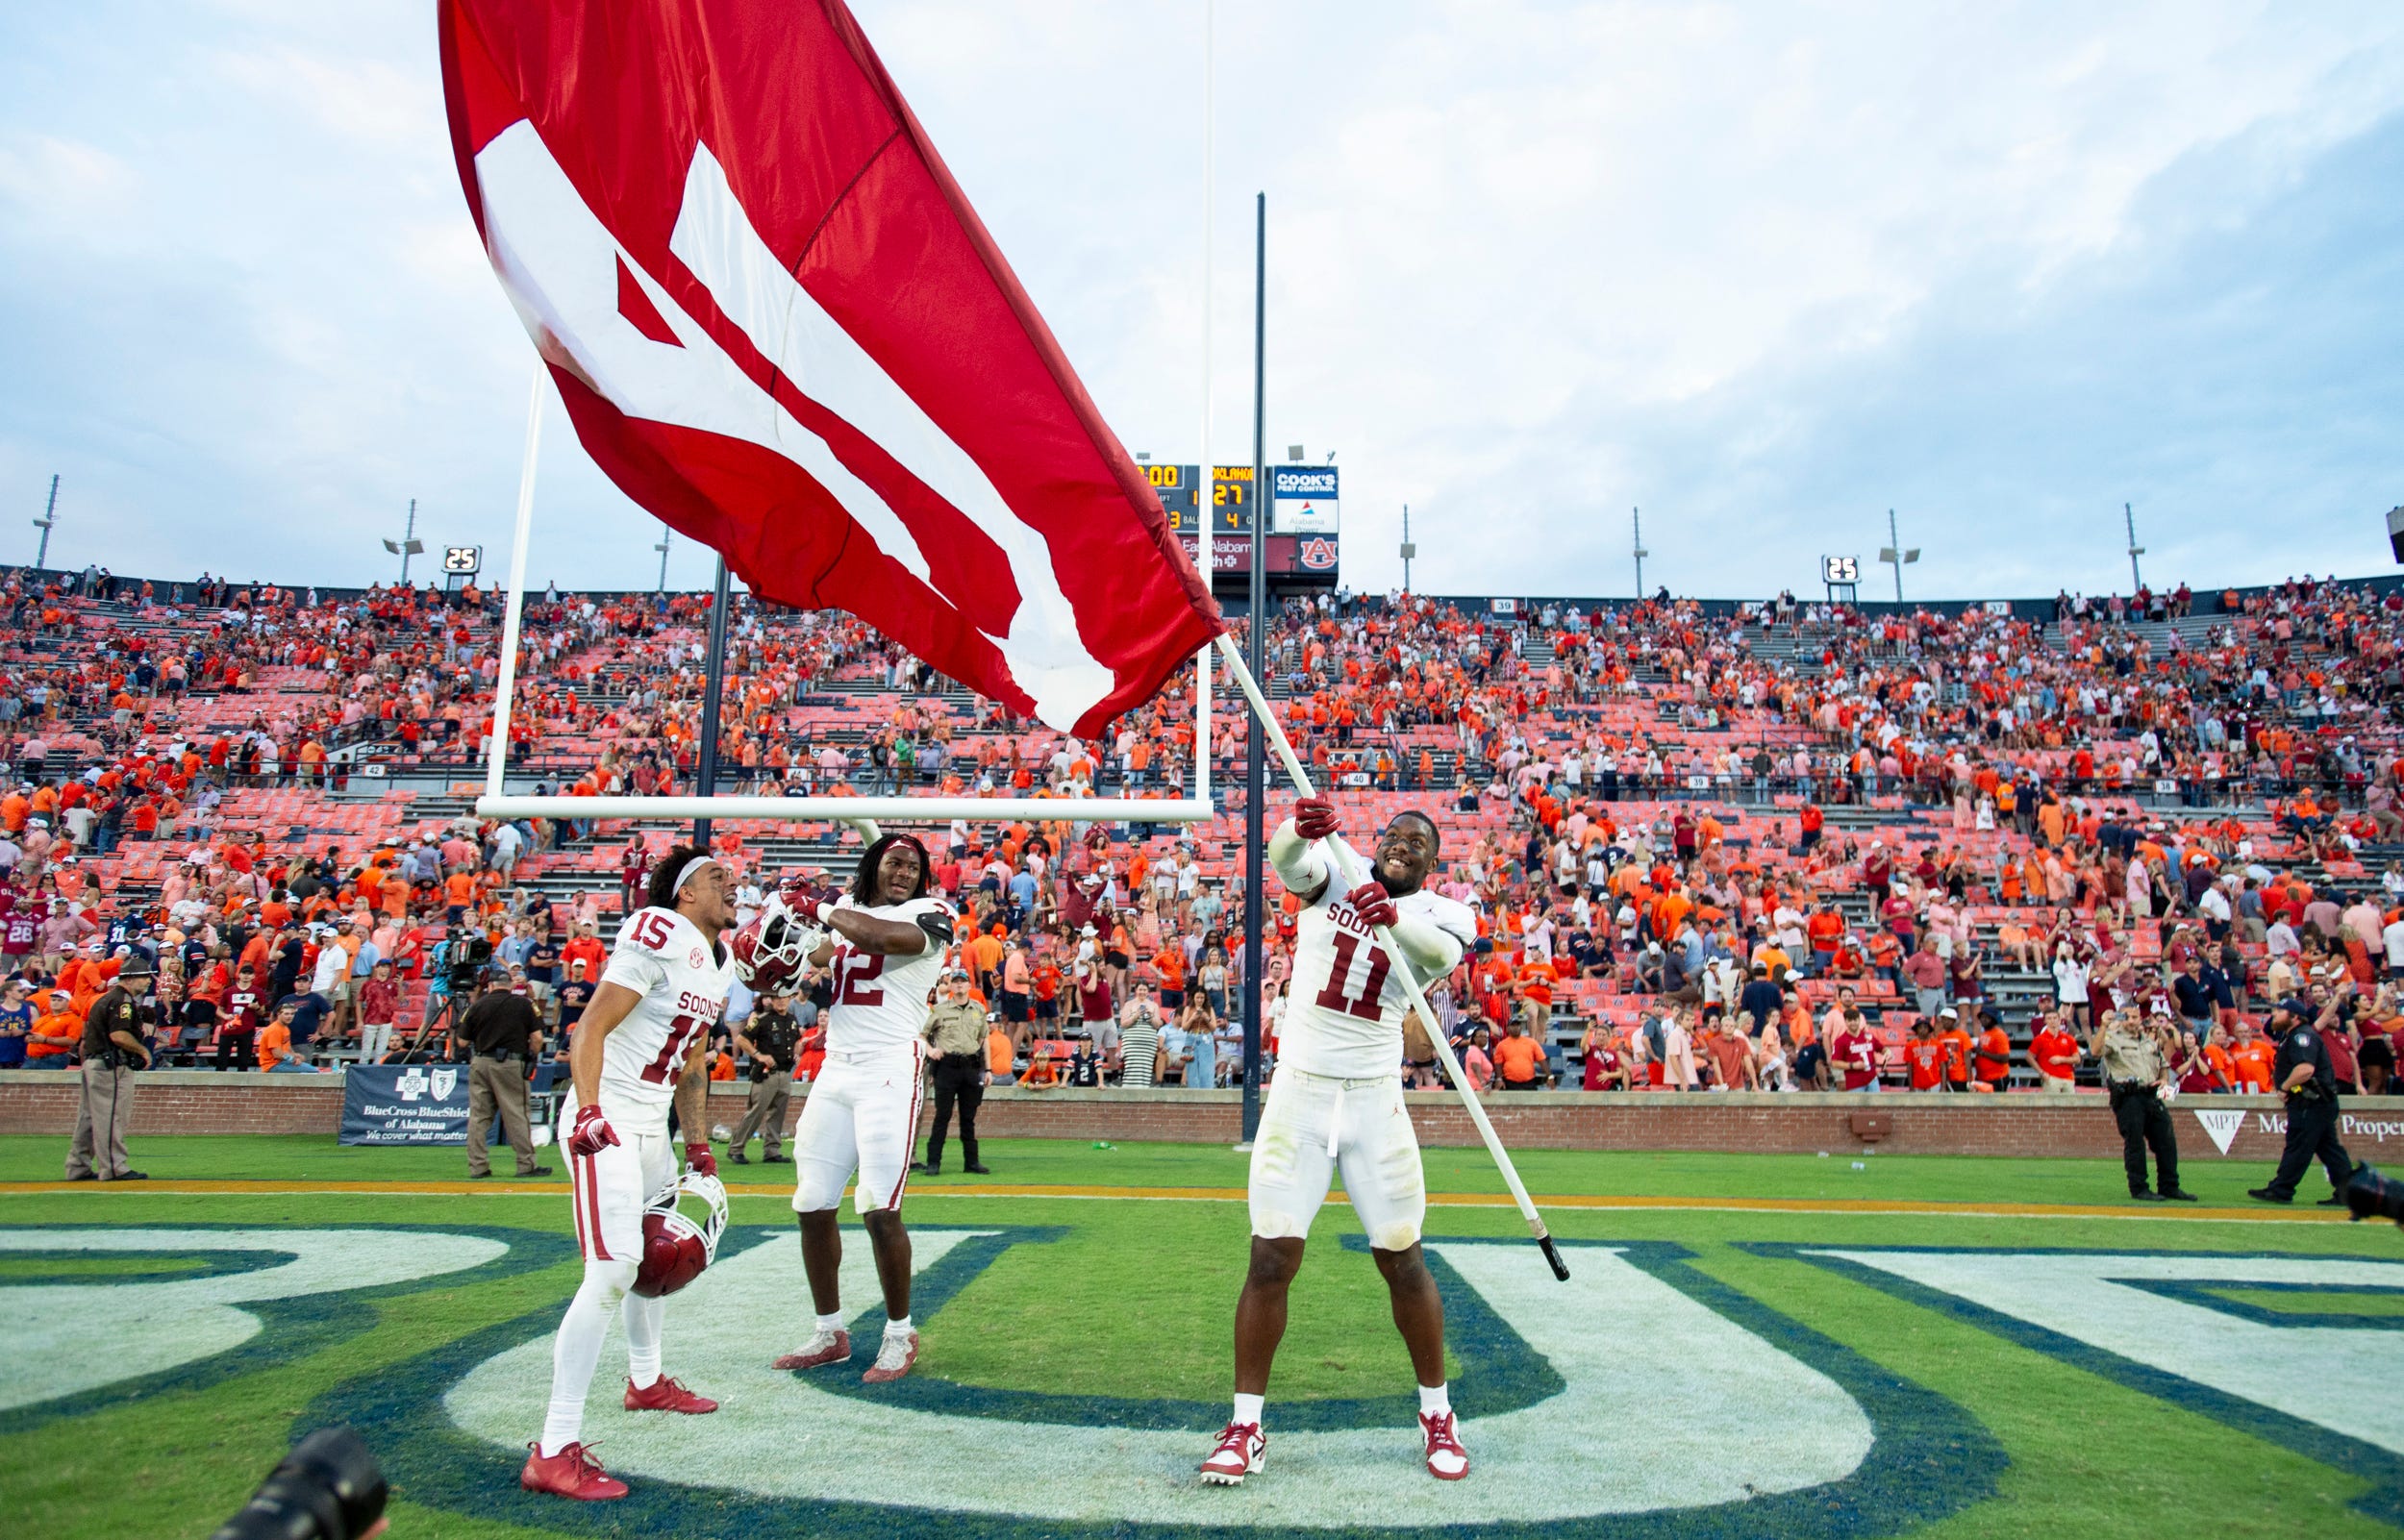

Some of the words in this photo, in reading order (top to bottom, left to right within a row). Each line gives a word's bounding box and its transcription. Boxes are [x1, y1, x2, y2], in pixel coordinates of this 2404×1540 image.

[1276, 473, 1336, 485] COOK'S
[1213, 484, 1243, 506] 27
[1226, 512, 1239, 529] 4
[1290, 516, 1325, 525] Alabama
[1183, 539, 1199, 552] Eas
[1212, 539, 1252, 553] Alabam
[446, 548, 474, 569] 25
[1829, 558, 1856, 579] 25
[1497, 601, 1511, 610] 39
[369, 765, 380, 775] 42
[1353, 775, 1364, 783] 40
[1327, 902, 1379, 942] SOON
[9, 926, 34, 943] 28
[110, 927, 126, 943] 31
[630, 911, 675, 951] 15
[1315, 930, 1391, 1023] 11
[678, 991, 725, 1020] SOONE
[1079, 1066, 1089, 1082] 2
[363, 1105, 417, 1116] BlueCross
[418, 1106, 470, 1117] BlueShiel
[385, 1119, 398, 1129] of
[399, 1119, 446, 1130] Alabama
[2207, 1114, 2241, 1130] MPT
[365, 1130, 381, 1140] We
[409, 1130, 432, 1141] what
